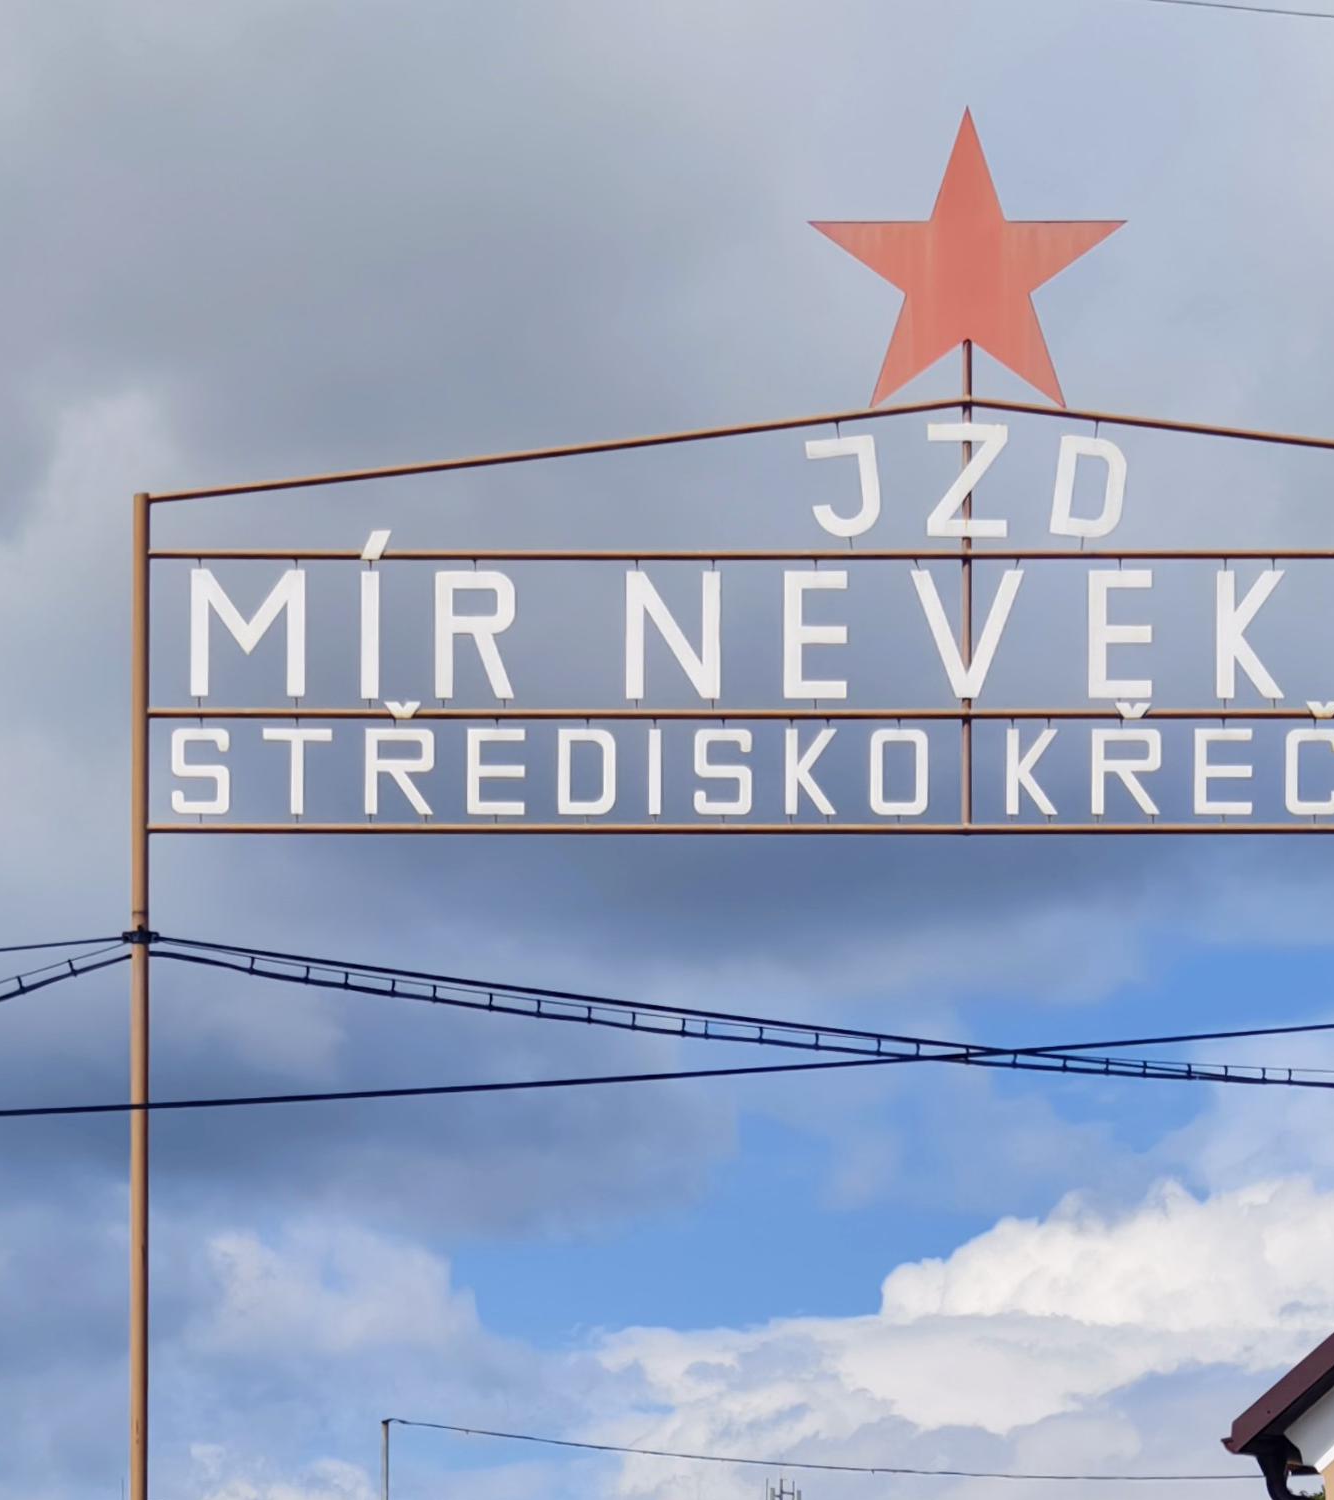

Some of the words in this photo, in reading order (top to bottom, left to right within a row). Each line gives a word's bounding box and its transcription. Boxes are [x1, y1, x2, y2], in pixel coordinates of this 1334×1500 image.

[804, 423, 1128, 538] JZD
[190, 529, 517, 699] MÍR
[170, 701, 929, 816] STŘEDISKO
